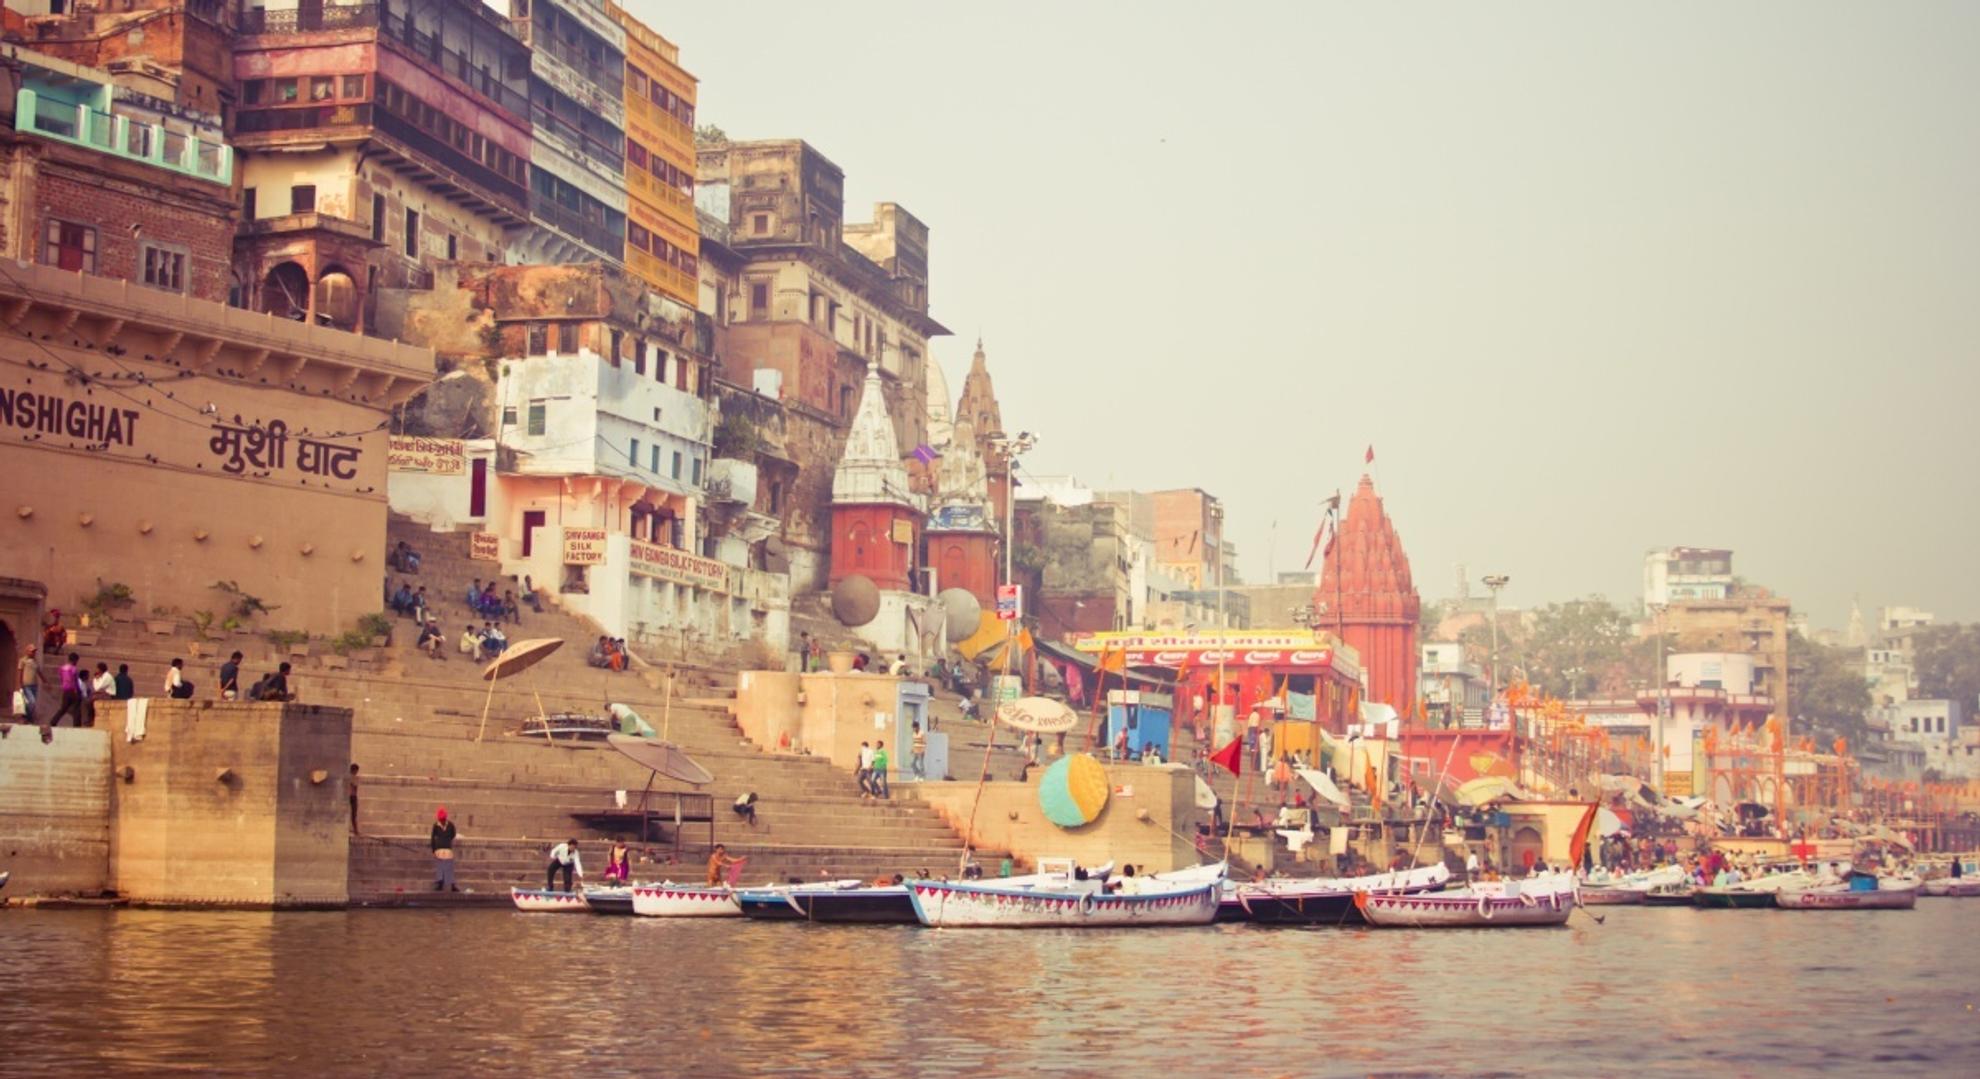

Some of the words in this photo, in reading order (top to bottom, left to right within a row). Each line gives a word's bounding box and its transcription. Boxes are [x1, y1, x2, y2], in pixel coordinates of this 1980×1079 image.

[297, 438, 363, 480] घाट
[570, 541, 592, 550] SILK
[566, 551, 603, 560] FACTORY
[688, 557, 724, 578] FACTORY
